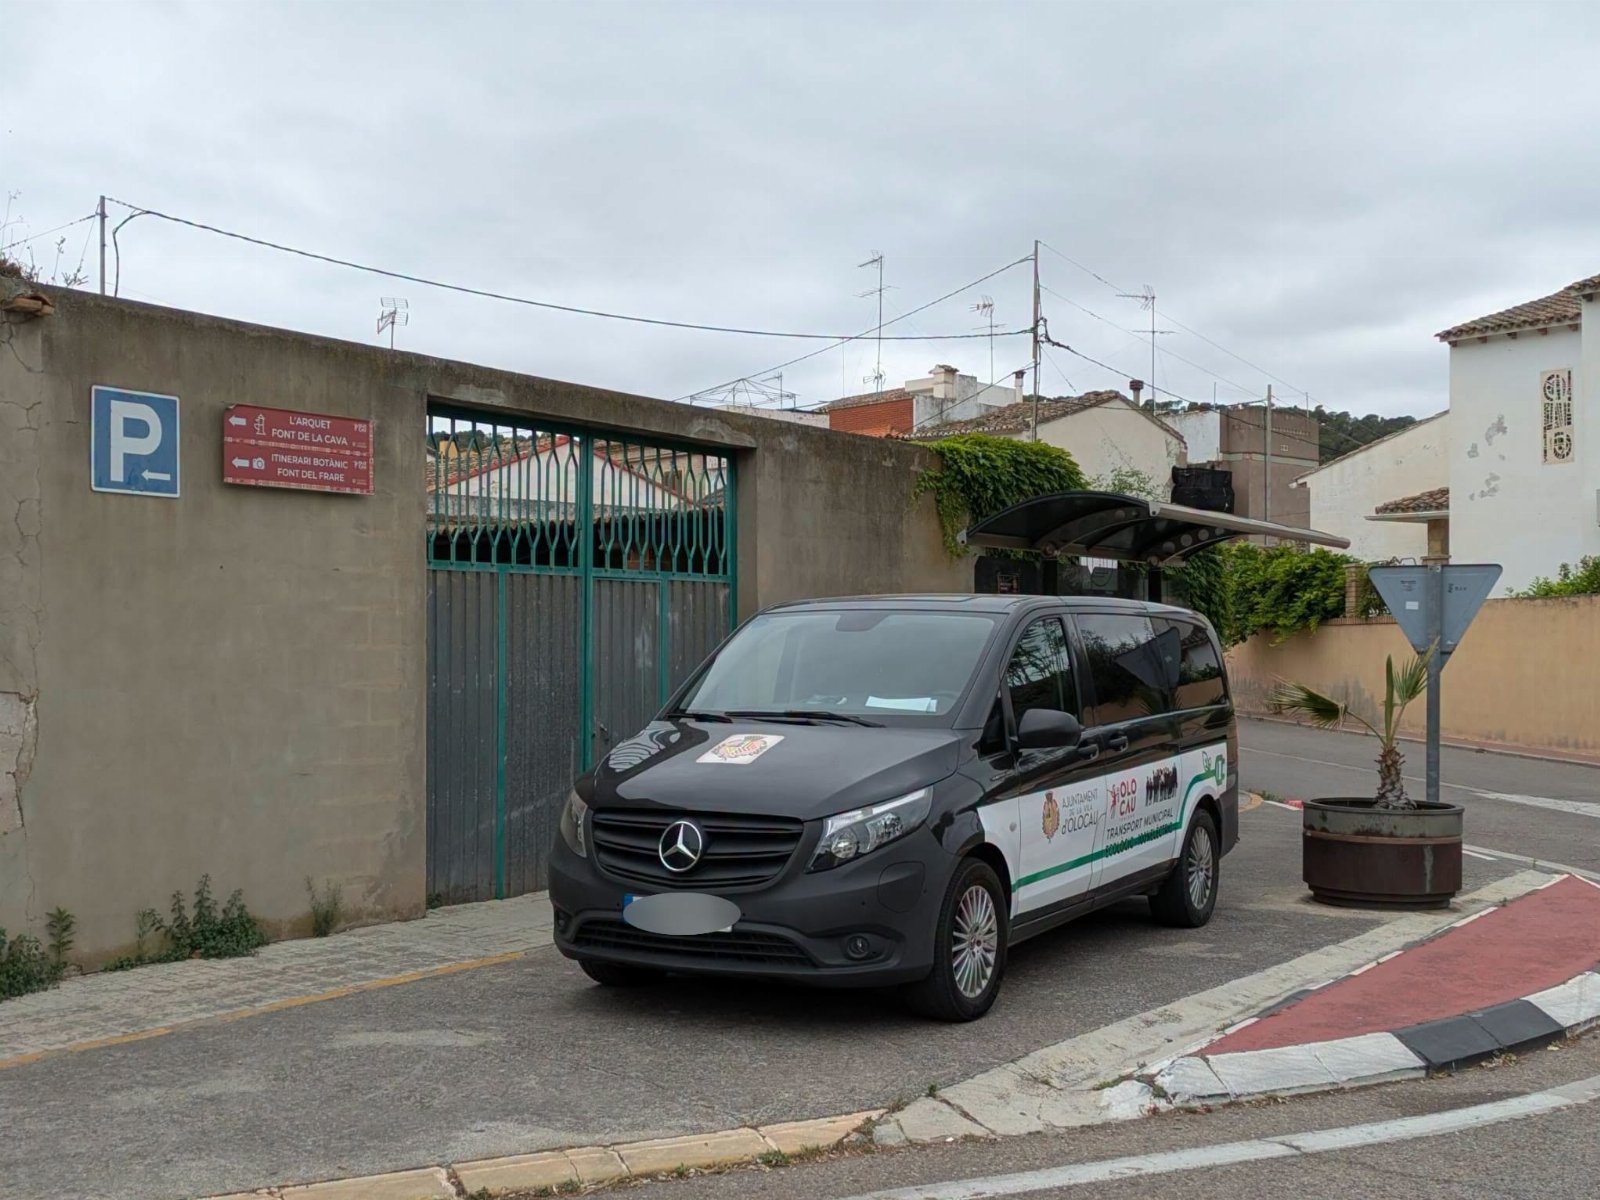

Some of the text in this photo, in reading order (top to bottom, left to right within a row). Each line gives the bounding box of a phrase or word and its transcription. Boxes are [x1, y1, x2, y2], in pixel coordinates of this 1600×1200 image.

[289, 416, 331, 429] L'ARQUET
[110, 400, 162, 482] P
[271, 428, 296, 439] FONT
[297, 432, 310, 441] DE
[311, 433, 323, 442] LA
[324, 435, 348, 446] CAVA
[271, 453, 312, 465] ITINERARI
[312, 457, 348, 469] BOTÀNIC
[277, 467, 344, 481] FONT DEL FRARE
[1120, 778, 1137, 798] OLO
[1062, 789, 1098, 808] AJUNTAMENT
[1120, 795, 1137, 816] CAU
[1106, 807, 1173, 840] TRANSPORT MUNICIPAL
